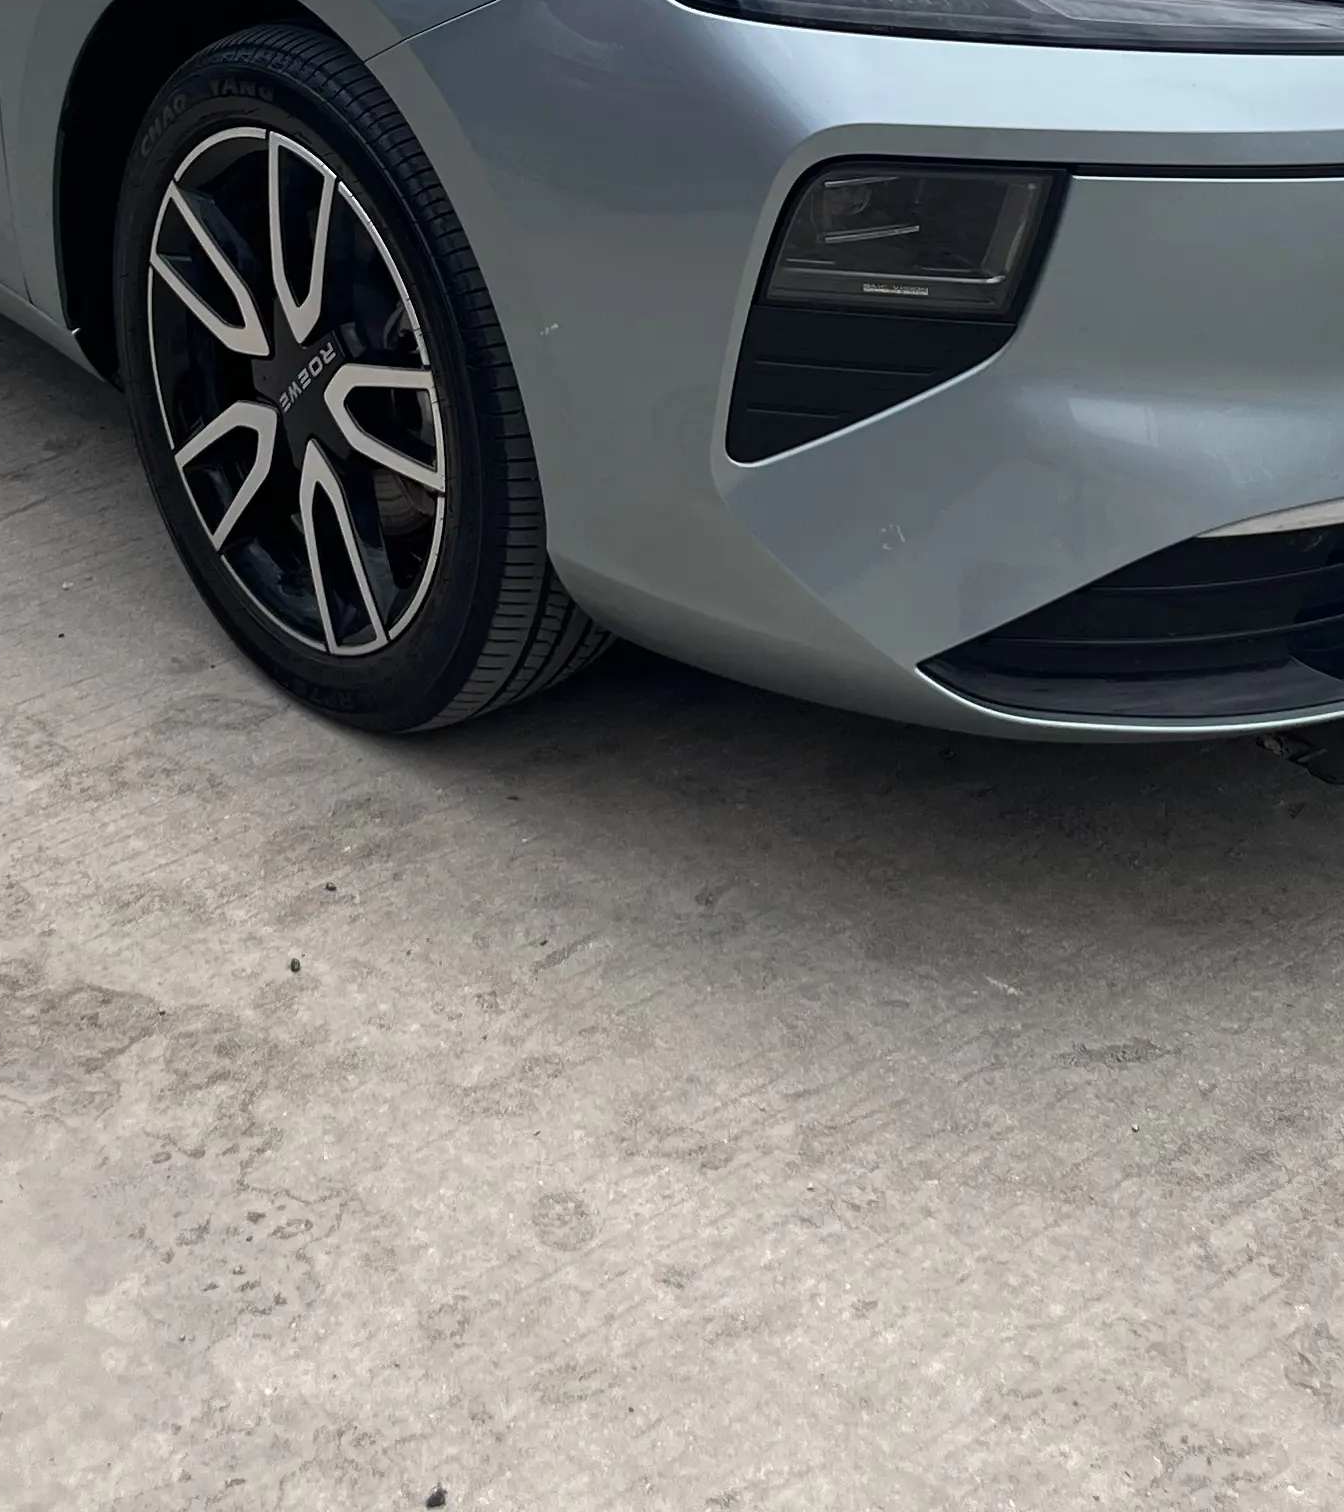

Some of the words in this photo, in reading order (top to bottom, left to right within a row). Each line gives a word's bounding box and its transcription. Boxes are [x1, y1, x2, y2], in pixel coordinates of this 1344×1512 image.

[140, 92, 188, 158] CHAO
[208, 76, 275, 103] YANG
[277, 340, 338, 415] ROEWE
